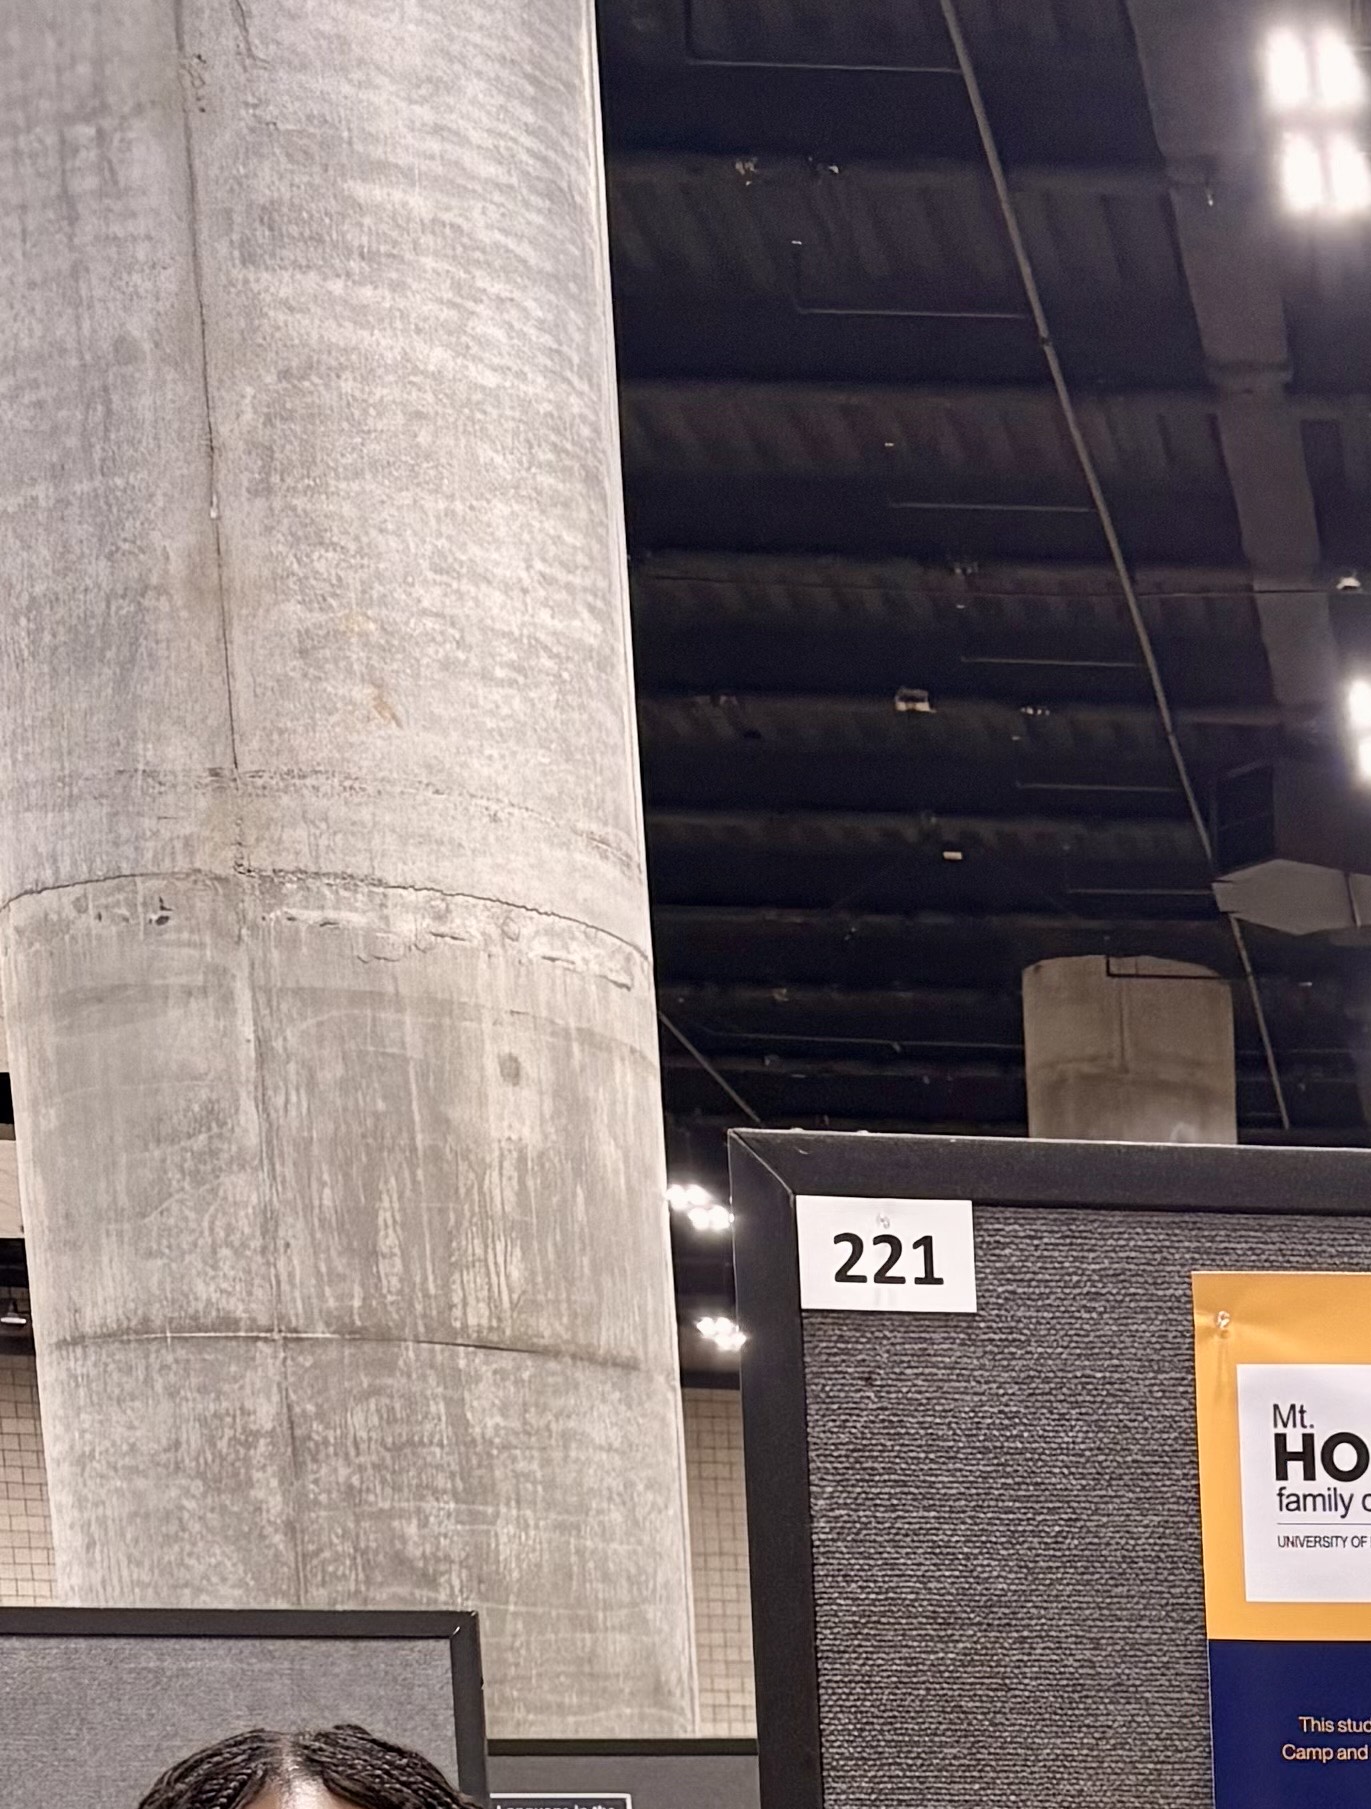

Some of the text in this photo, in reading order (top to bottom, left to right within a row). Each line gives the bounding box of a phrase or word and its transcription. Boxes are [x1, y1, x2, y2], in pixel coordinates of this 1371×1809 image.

[833, 1232, 944, 1285] 221
[1272, 1403, 1314, 1428] Mt.
[1276, 1486, 1354, 1519] family
[1277, 1535, 1348, 1548] UNIVERSITY
[1350, 1535, 1367, 1548] OF
[1298, 1716, 1334, 1732] This
